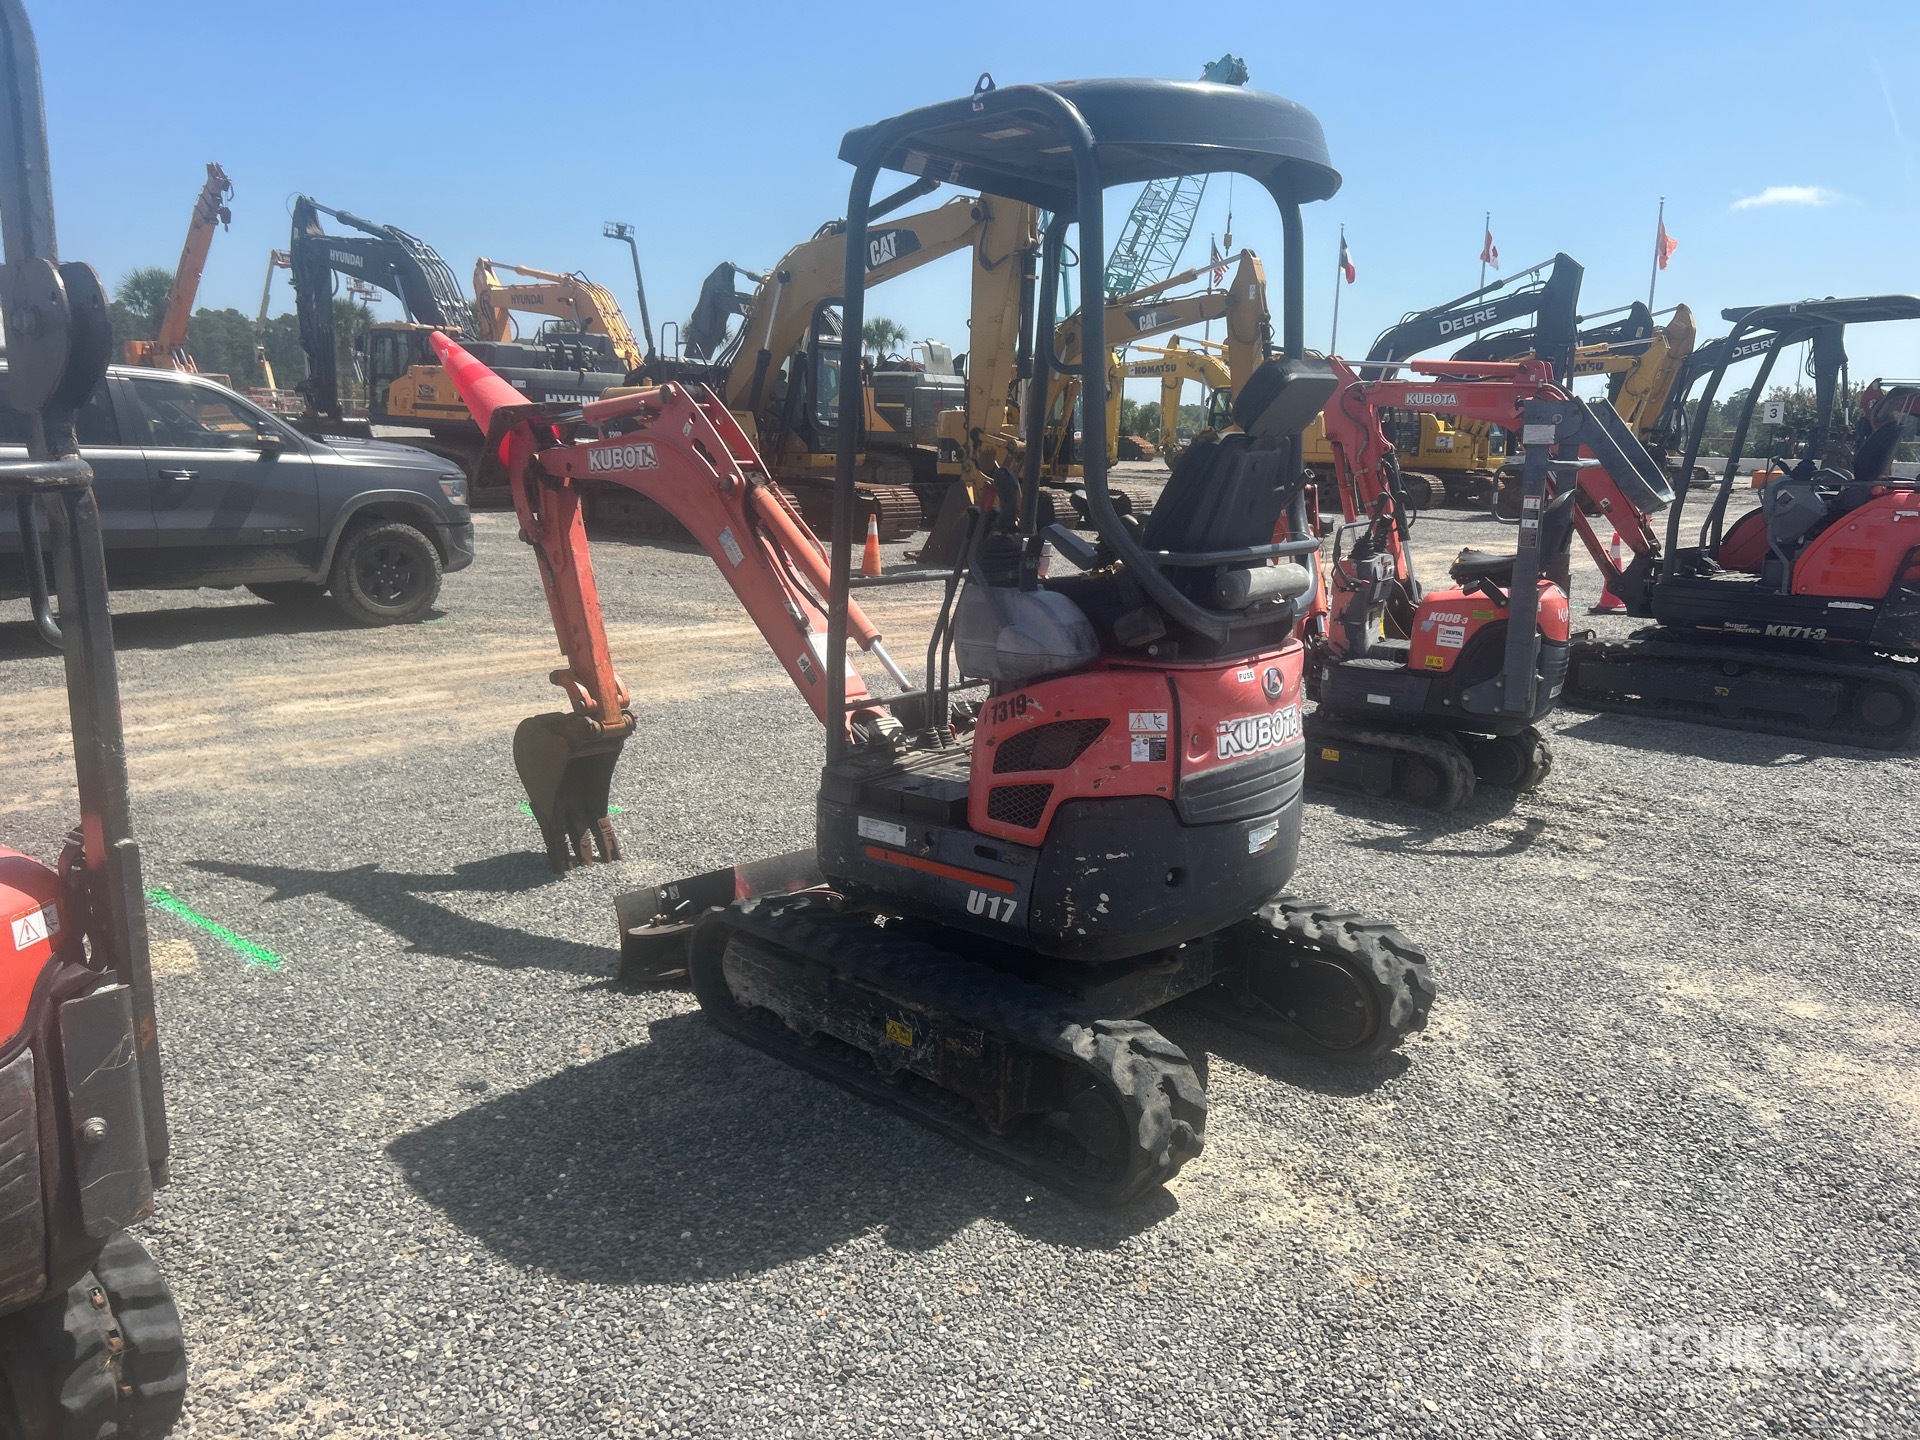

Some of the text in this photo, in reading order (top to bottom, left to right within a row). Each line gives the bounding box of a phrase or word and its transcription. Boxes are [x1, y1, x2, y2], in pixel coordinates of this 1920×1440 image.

[870, 232, 896, 266] CAT
[330, 249, 363, 267] HYUNDAI
[511, 294, 543, 304] HYUNDAI
[1139, 312, 1157, 331] CAT
[1439, 307, 1497, 335] DEERE
[1134, 364, 1177, 374] KOMATSU
[1406, 394, 1457, 405] KUBOTA
[1769, 408, 1778, 418] 3
[589, 446, 657, 472] KUBOTA
[1429, 611, 1469, 625] K008-3
[1764, 624, 1828, 641] KX71-3
[1238, 671, 1255, 681] FUSE
[1217, 704, 1300, 759] KUBOTA
[966, 890, 1018, 923] U17
